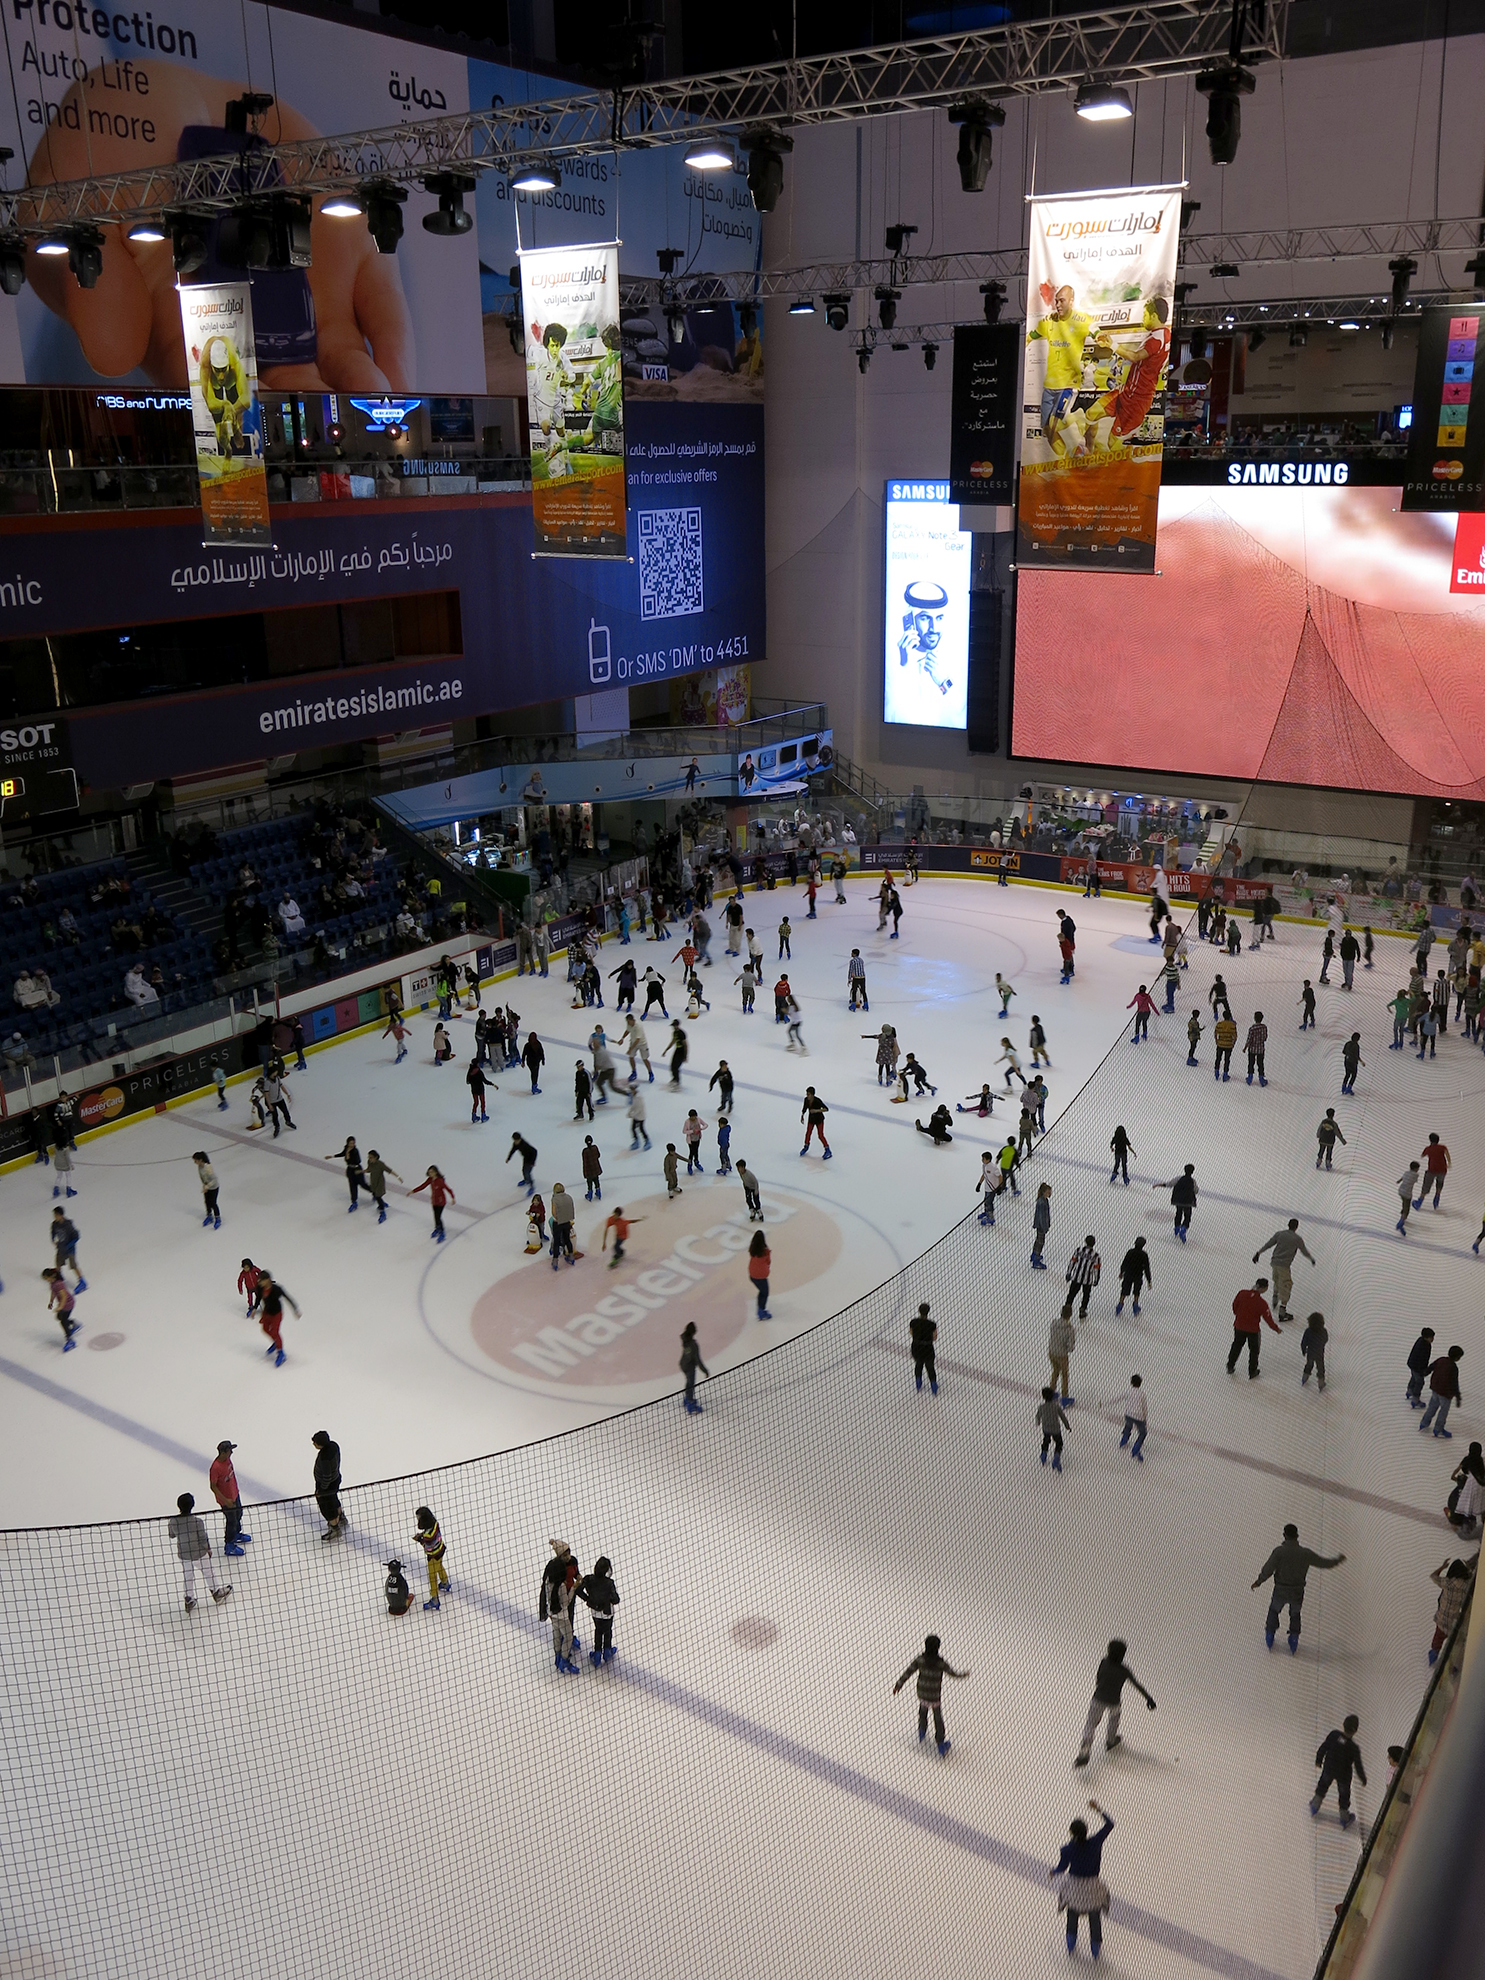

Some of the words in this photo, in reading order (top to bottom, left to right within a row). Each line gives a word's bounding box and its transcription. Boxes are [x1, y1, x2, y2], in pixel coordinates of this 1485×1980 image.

[14, 0, 198, 59] Protection
[22, 41, 95, 88] Auto,
[101, 56, 149, 95] Life
[389, 70, 447, 111] حماية
[27, 99, 80, 130] and
[88, 109, 155, 143] more
[703, 213, 752, 245] وخصومات
[1063, 246, 1102, 263] إماراتي
[1106, 244, 1142, 256] الهدف
[543, 293, 570, 307] إماراتي
[572, 291, 596, 303] الهدف
[644, 367, 667, 381] VISA
[969, 390, 998, 401] حصرية
[978, 407, 988, 418] مع
[640, 470, 654, 485] for
[654, 469, 693, 484] exclusive
[693, 468, 718, 483] offers
[1227, 463, 1349, 484] SAMSUNG
[1432, 466, 1464, 474] MasterCard
[952, 480, 1008, 489] PRICELESS
[1407, 482, 1482, 492] PRICELESS
[928, 531, 948, 540] Note
[412, 531, 453, 568] مرحباً
[944, 542, 965, 551] Gear
[269, 549, 336, 583] الإمارات
[339, 546, 373, 577] في
[377, 541, 411, 573] بكم
[170, 555, 266, 593] الإسلامي
[617, 657, 634, 679] Or
[636, 650, 666, 675] SMS
[700, 644, 714, 663] to
[716, 635, 749, 660] 4451
[258, 678, 464, 734] emiratesislamic.ae
[0, 722, 56, 751] SOT
[4, 750, 35, 765] SINCE
[38, 747, 60, 758] 1853
[1169, 874, 1190, 885] HITS
[1173, 884, 1191, 892] ROW
[129, 1048, 230, 1094] PRICELESS
[165, 1076, 199, 1094] ARABIA
[80, 1094, 124, 1118] MasterCard
